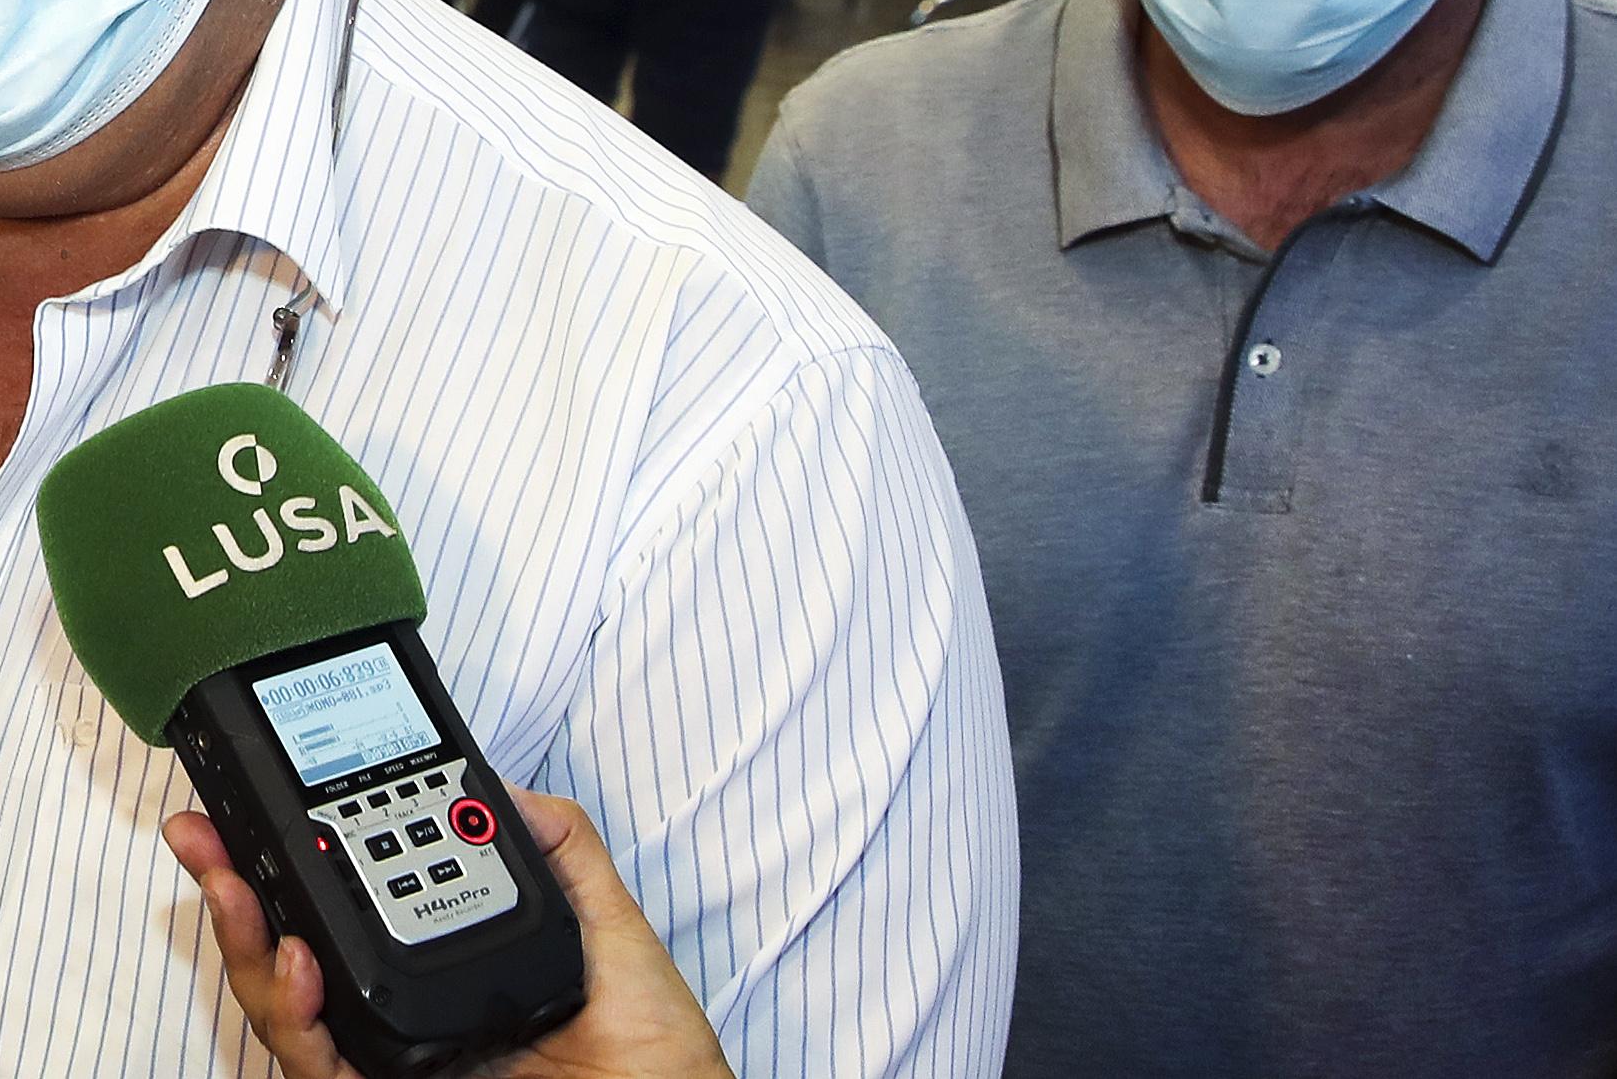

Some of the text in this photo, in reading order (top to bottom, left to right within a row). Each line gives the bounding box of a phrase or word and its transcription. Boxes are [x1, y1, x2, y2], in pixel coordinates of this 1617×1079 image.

[162, 484, 397, 599] LUSA
[413, 886, 491, 920] H4n Pro
